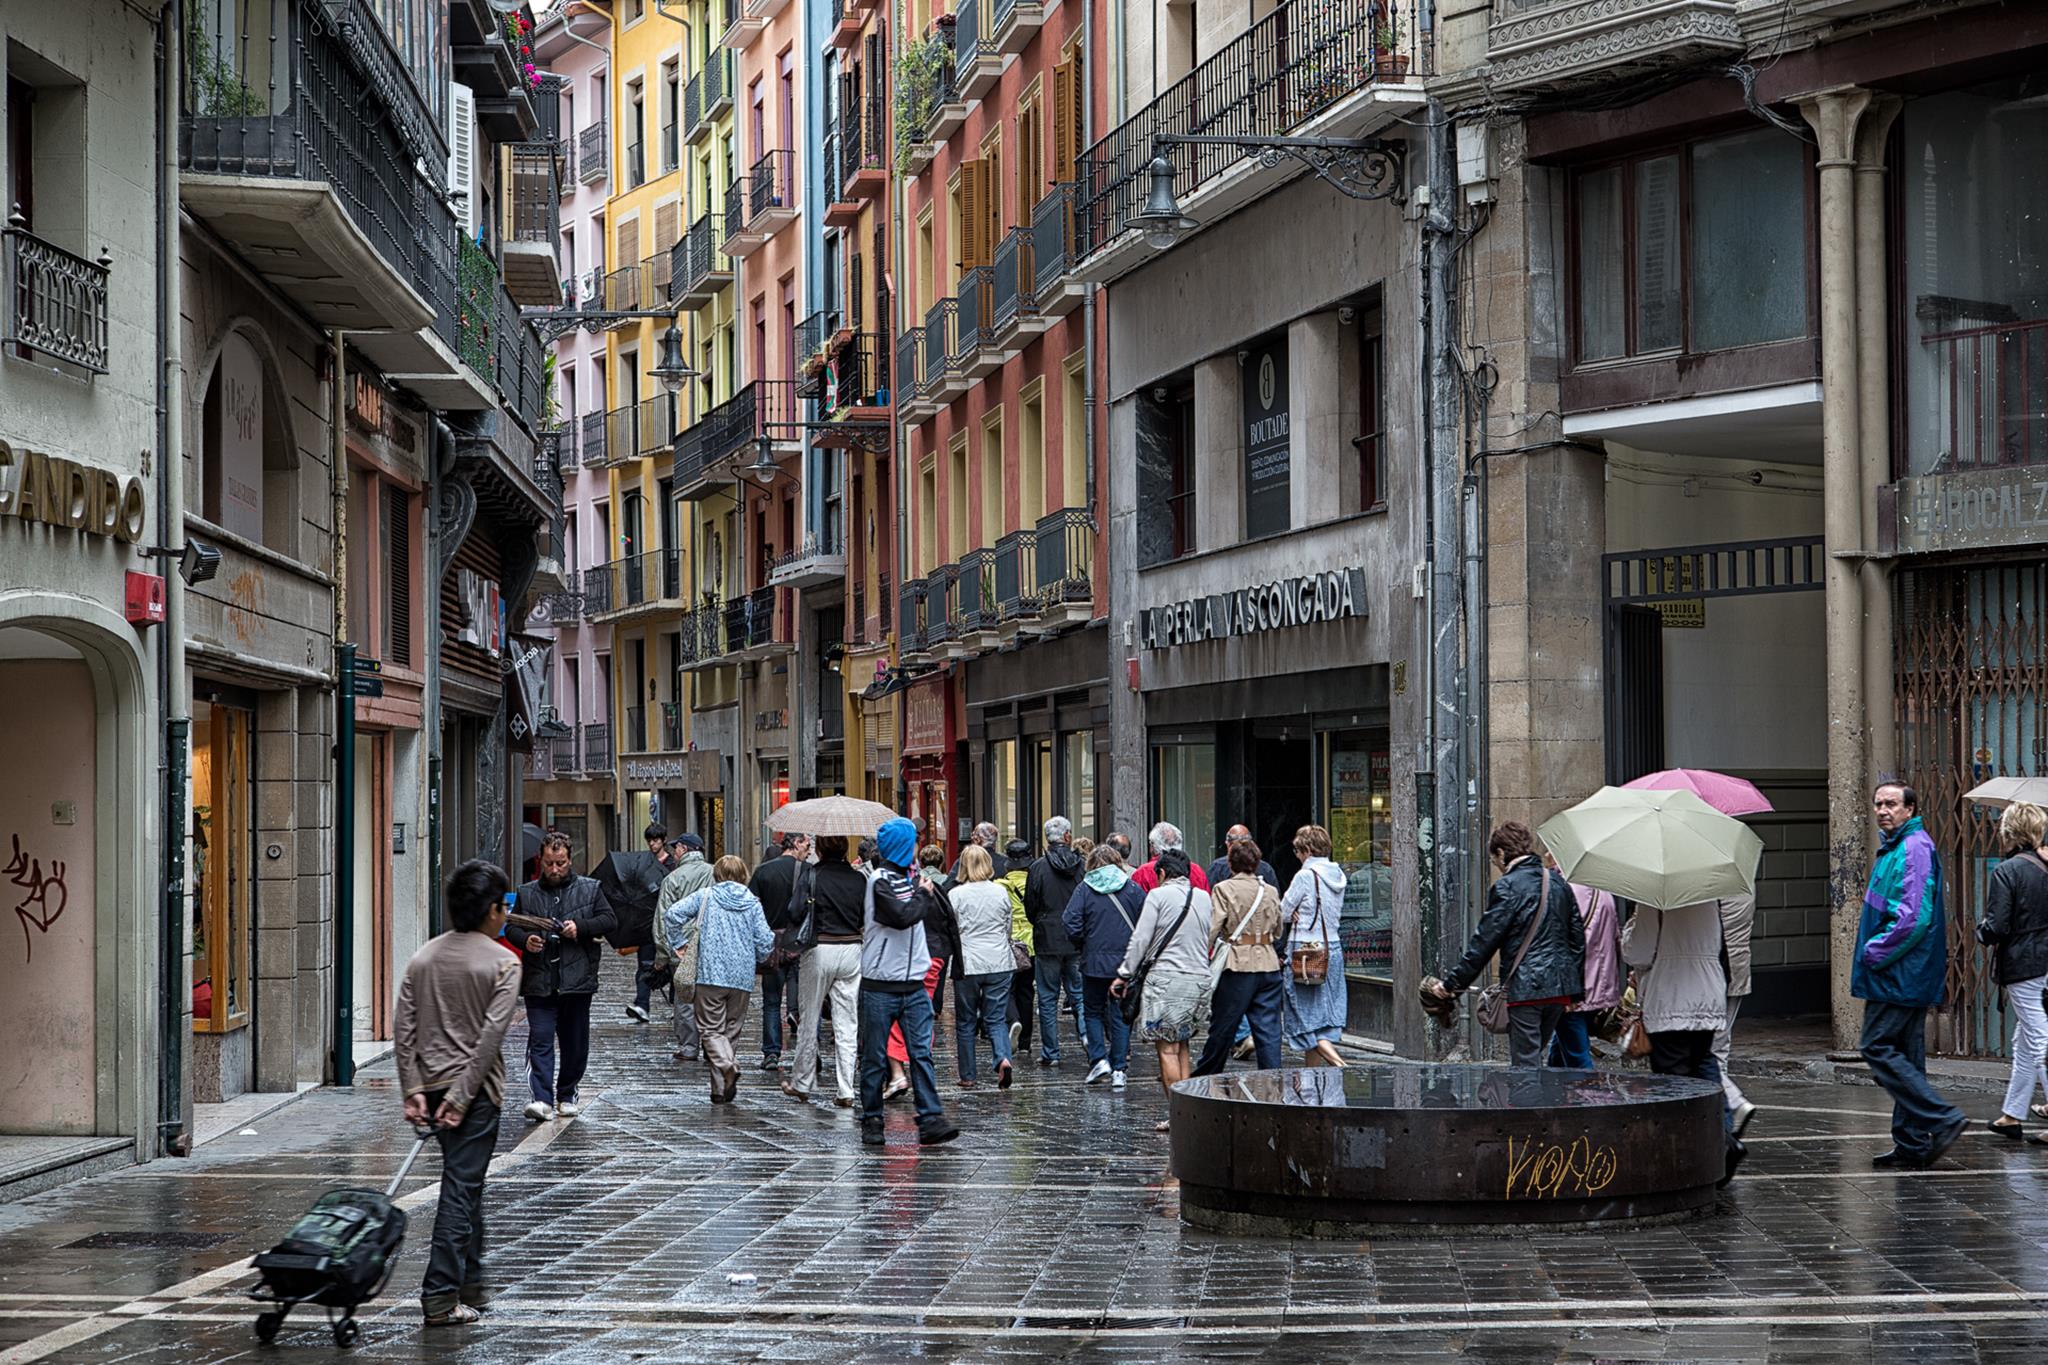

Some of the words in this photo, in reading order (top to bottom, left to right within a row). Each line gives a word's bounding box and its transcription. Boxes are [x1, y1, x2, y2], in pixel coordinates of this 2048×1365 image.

[1250, 412, 1289, 445] BOUTADE
[1140, 607, 1157, 650] LA
[1166, 597, 1214, 646] PERLA
[1222, 566, 1355, 637] VASCONGADA
